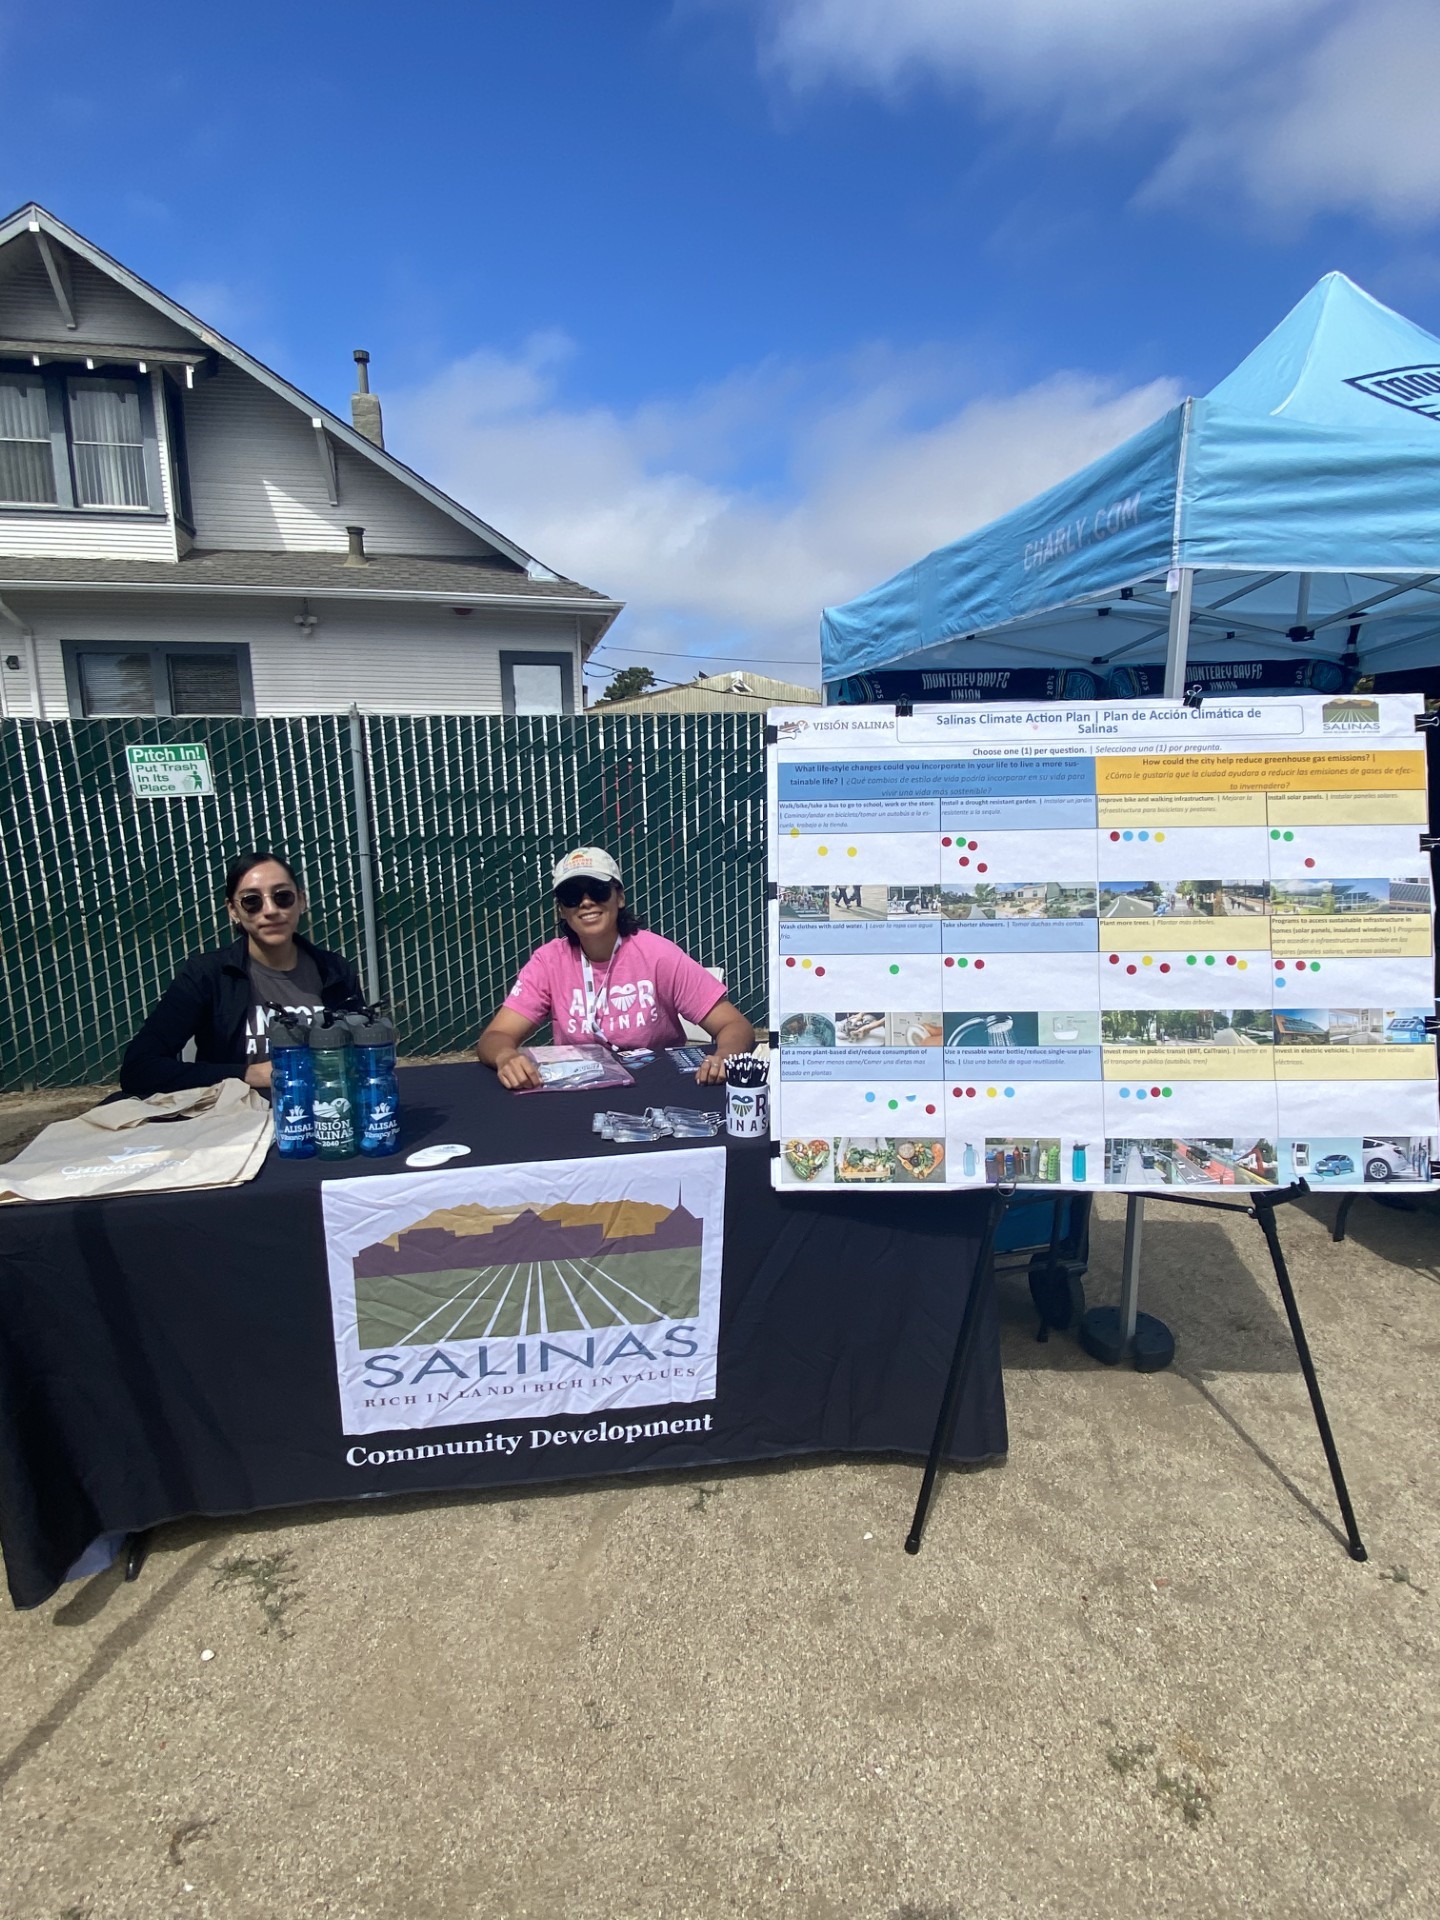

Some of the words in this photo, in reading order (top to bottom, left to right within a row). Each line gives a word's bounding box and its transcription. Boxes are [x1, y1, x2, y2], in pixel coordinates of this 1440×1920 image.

[1024, 491, 1141, 572] CHARLY.COM
[922, 673, 975, 690] MONTEREY
[937, 715, 976, 725] Salinas
[979, 713, 1022, 724] Climate
[1026, 712, 1062, 723] Action
[1066, 711, 1090, 722] Plan
[1104, 711, 1128, 721] Plan
[1132, 710, 1146, 720] de
[1149, 709, 1188, 720] Acción
[1191, 708, 1244, 719] Climática
[1248, 708, 1261, 718] de
[813, 720, 849, 731] VISIÓN
[852, 721, 895, 730] SALINAS
[1078, 723, 1118, 734] Salinas
[1323, 723, 1381, 731] SALINAS
[132, 748, 176, 762] Pitch
[180, 747, 201, 761] In!
[973, 748, 1001, 756] Choose
[1021, 747, 1032, 756] (1)
[1034, 748, 1047, 756] per
[1050, 746, 1087, 756] question.
[1096, 745, 1136, 753] Selecciona
[1155, 745, 1166, 754] (1)
[1168, 746, 1182, 754] por
[1184, 745, 1222, 754] pregunta.
[1201, 757, 1214, 766] city
[1216, 757, 1234, 766] help
[1235, 756, 1262, 764] reduce
[1264, 755, 1311, 764] greenhouse
[1312, 756, 1326, 764] gas
[1328, 754, 1370, 762] emissions?
[135, 764, 157, 773] Put
[160, 763, 198, 772] Trash
[795, 764, 816, 772] What
[817, 763, 850, 773] life-style
[851, 763, 881, 773] changes
[883, 763, 904, 771] could
[922, 762, 966, 772] incorporate
[977, 763, 994, 771] your
[996, 761, 1008, 769] life
[137, 775, 149, 783] In
[154, 774, 169, 782] Its
[790, 777, 820, 786] tainable
[822, 777, 838, 785] life?
[867, 775, 898, 785] cambios
[944, 774, 959, 782] vida
[987, 773, 1026, 783] incorporar
[1067, 773, 1085, 781] para
[1175, 771, 1189, 780] que
[1192, 770, 1198, 778] la
[1201, 769, 1225, 777] ciudad
[1268, 768, 1295, 777] reducir
[1297, 768, 1308, 776] las
[1310, 768, 1348, 776] emisiones
[1350, 767, 1359, 775] de
[1361, 768, 1382, 776] gases
[139, 784, 176, 793] Place
[285, 1123, 314, 1133] ALISAL
[369, 1120, 397, 1131] ALISAL
[314, 1127, 354, 1140] ALINAS
[363, 1324, 700, 1389] SALINAS
[364, 1393, 417, 1408] RICH
[427, 1392, 450, 1404] IN
[459, 1384, 514, 1400] LAND
[534, 1379, 583, 1393] RICH
[591, 1376, 613, 1388] IN
[622, 1367, 696, 1384] VALUES
[346, 1432, 523, 1467] Community
[529, 1413, 713, 1449] Development
